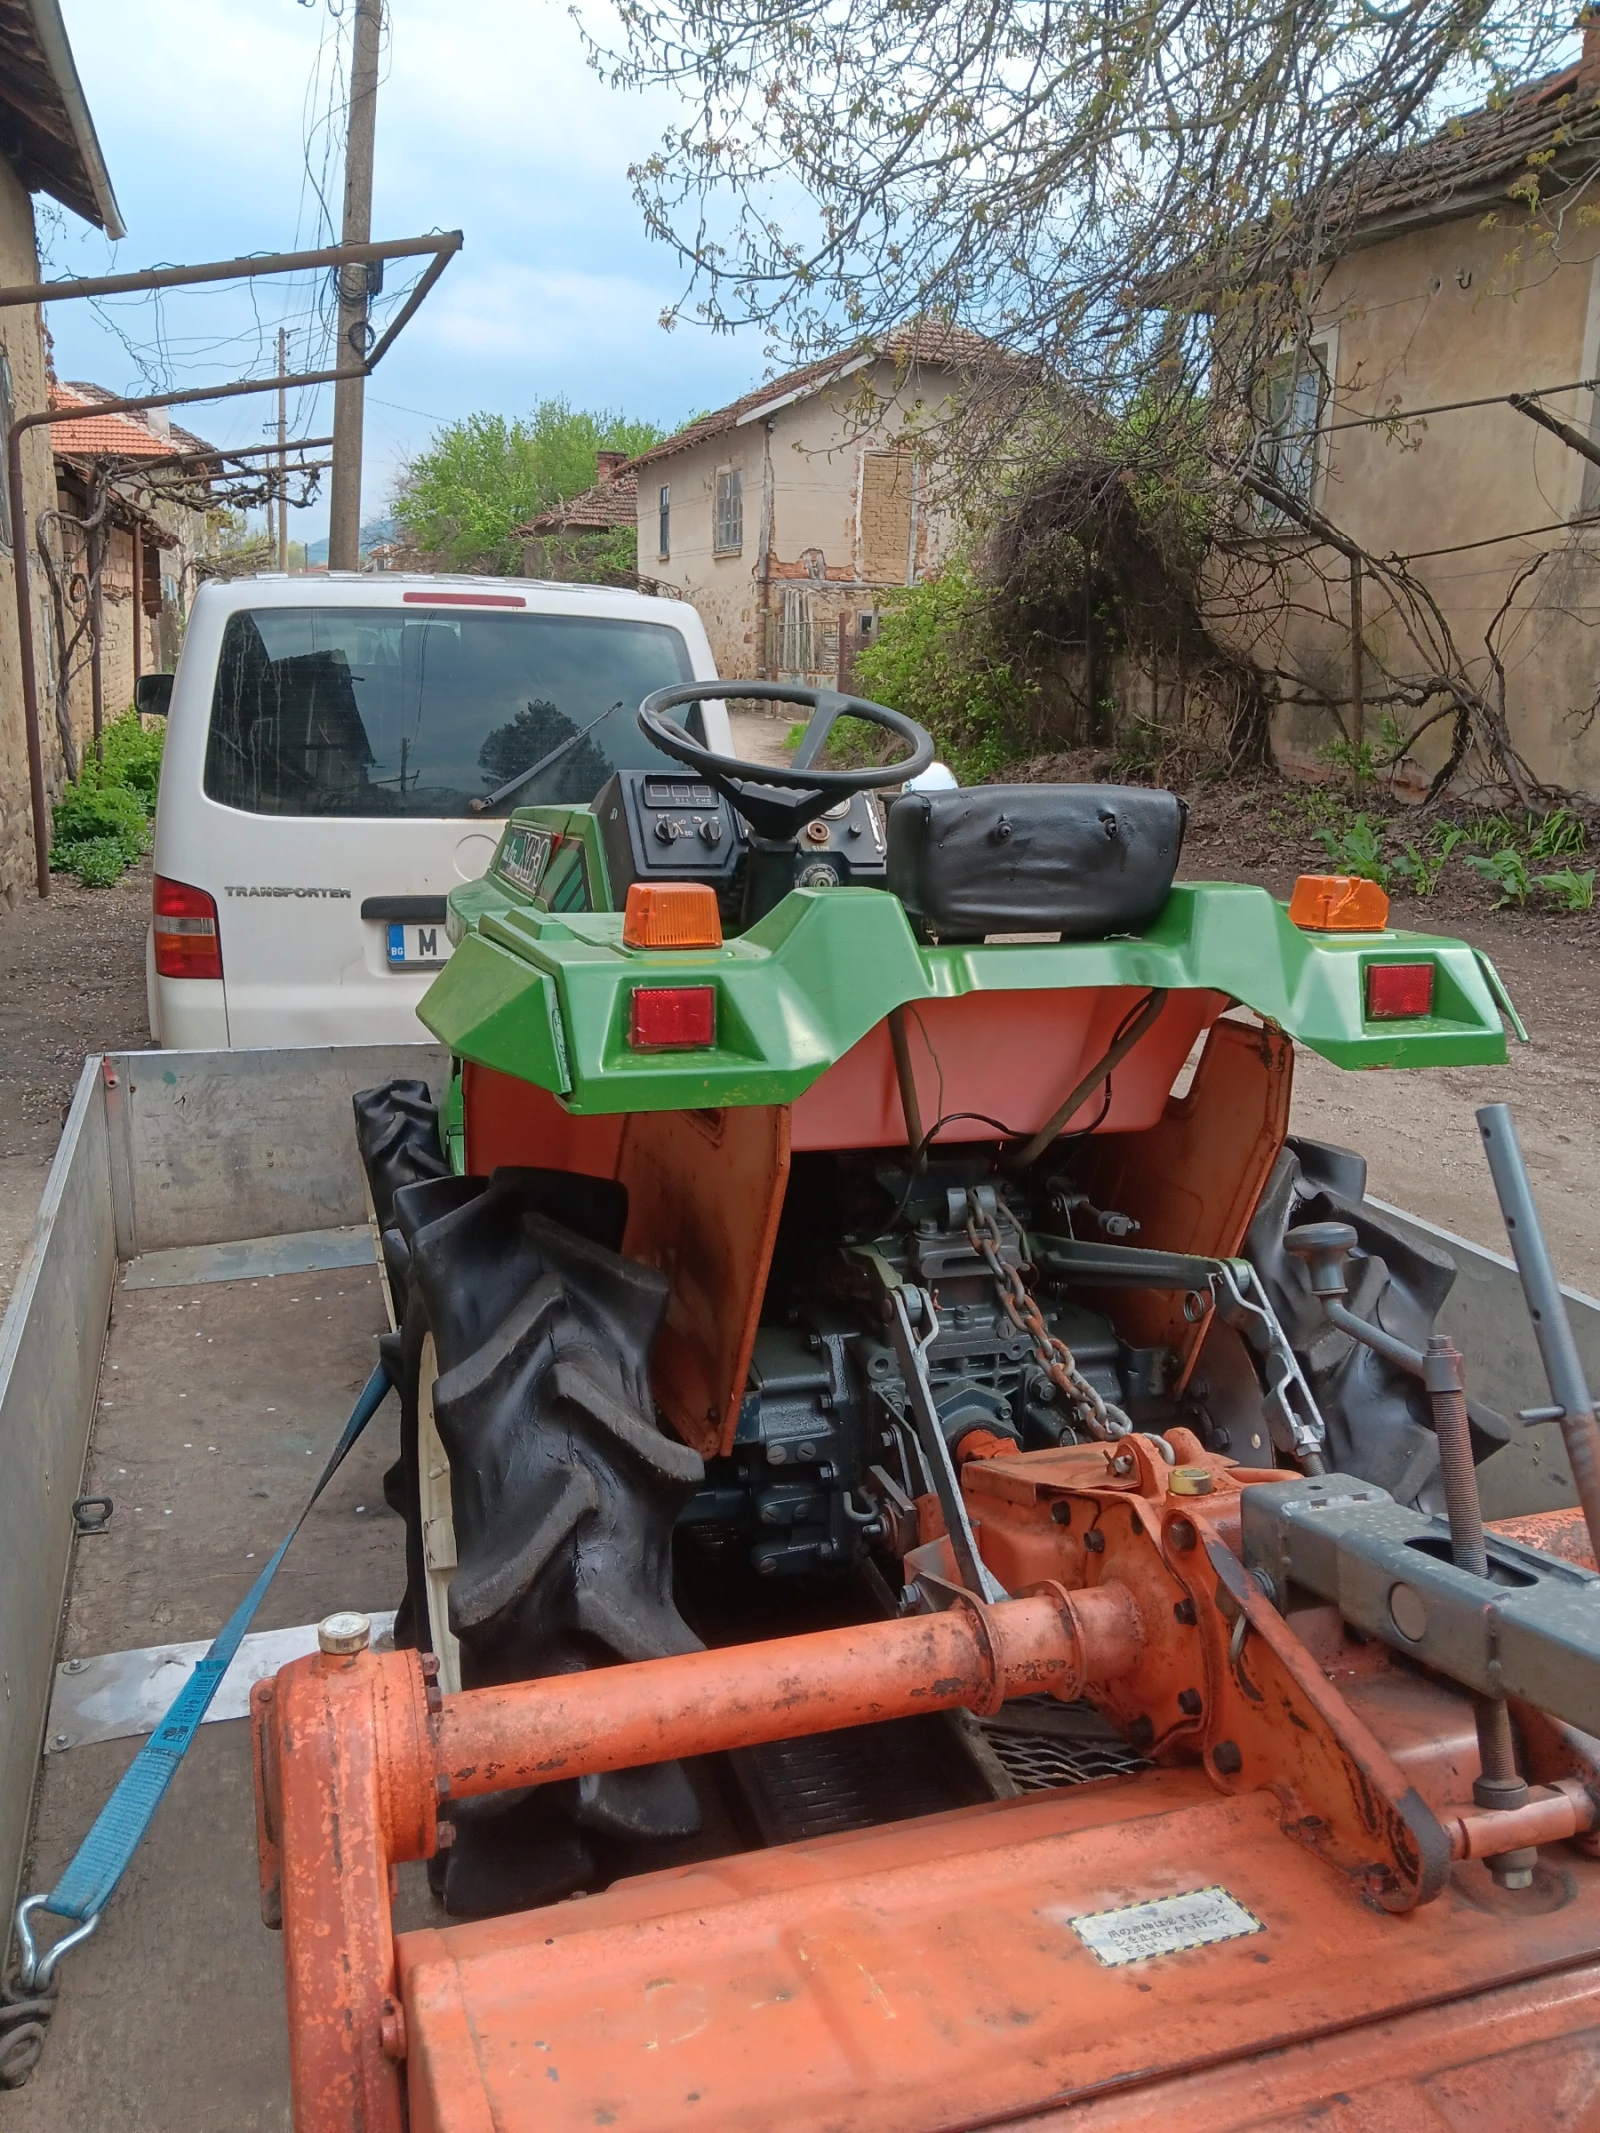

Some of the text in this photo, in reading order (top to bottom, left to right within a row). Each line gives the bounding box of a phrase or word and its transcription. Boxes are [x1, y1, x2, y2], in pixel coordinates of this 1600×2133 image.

[224, 886, 351, 898] TRANSPORTER
[418, 928, 437, 956] M
[391, 947, 403, 956] BG
